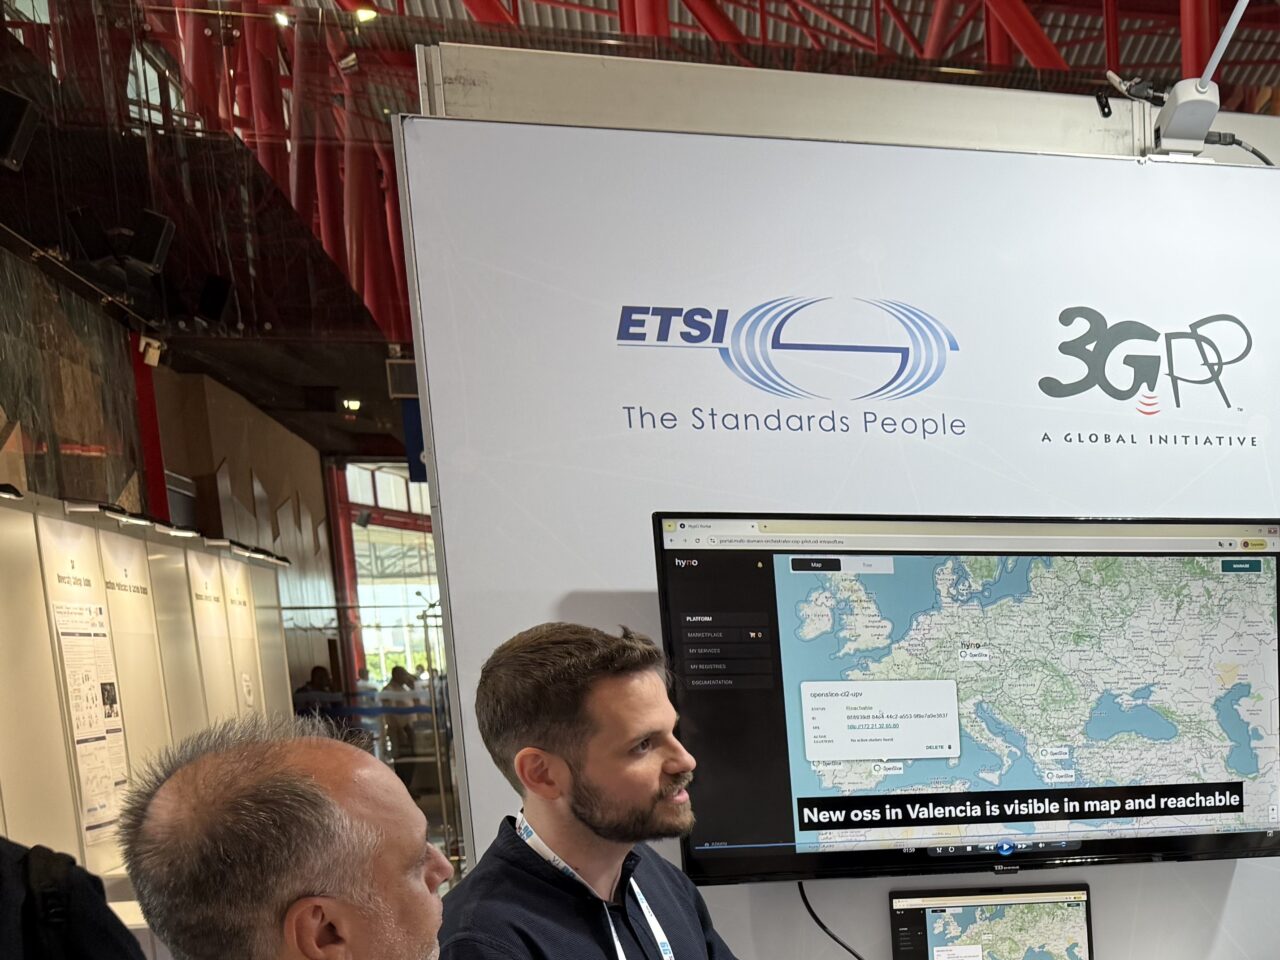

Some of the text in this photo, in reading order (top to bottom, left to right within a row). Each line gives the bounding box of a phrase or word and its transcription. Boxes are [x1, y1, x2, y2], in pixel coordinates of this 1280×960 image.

[616, 306, 729, 344] ETSI
[623, 406, 967, 441] The Standards People
[1041, 432, 1258, 447] A GLOBAL INITIATIVE
[810, 561, 823, 569] Map
[803, 791, 1240, 823] New oss in Valencia is visible in map and reachable
